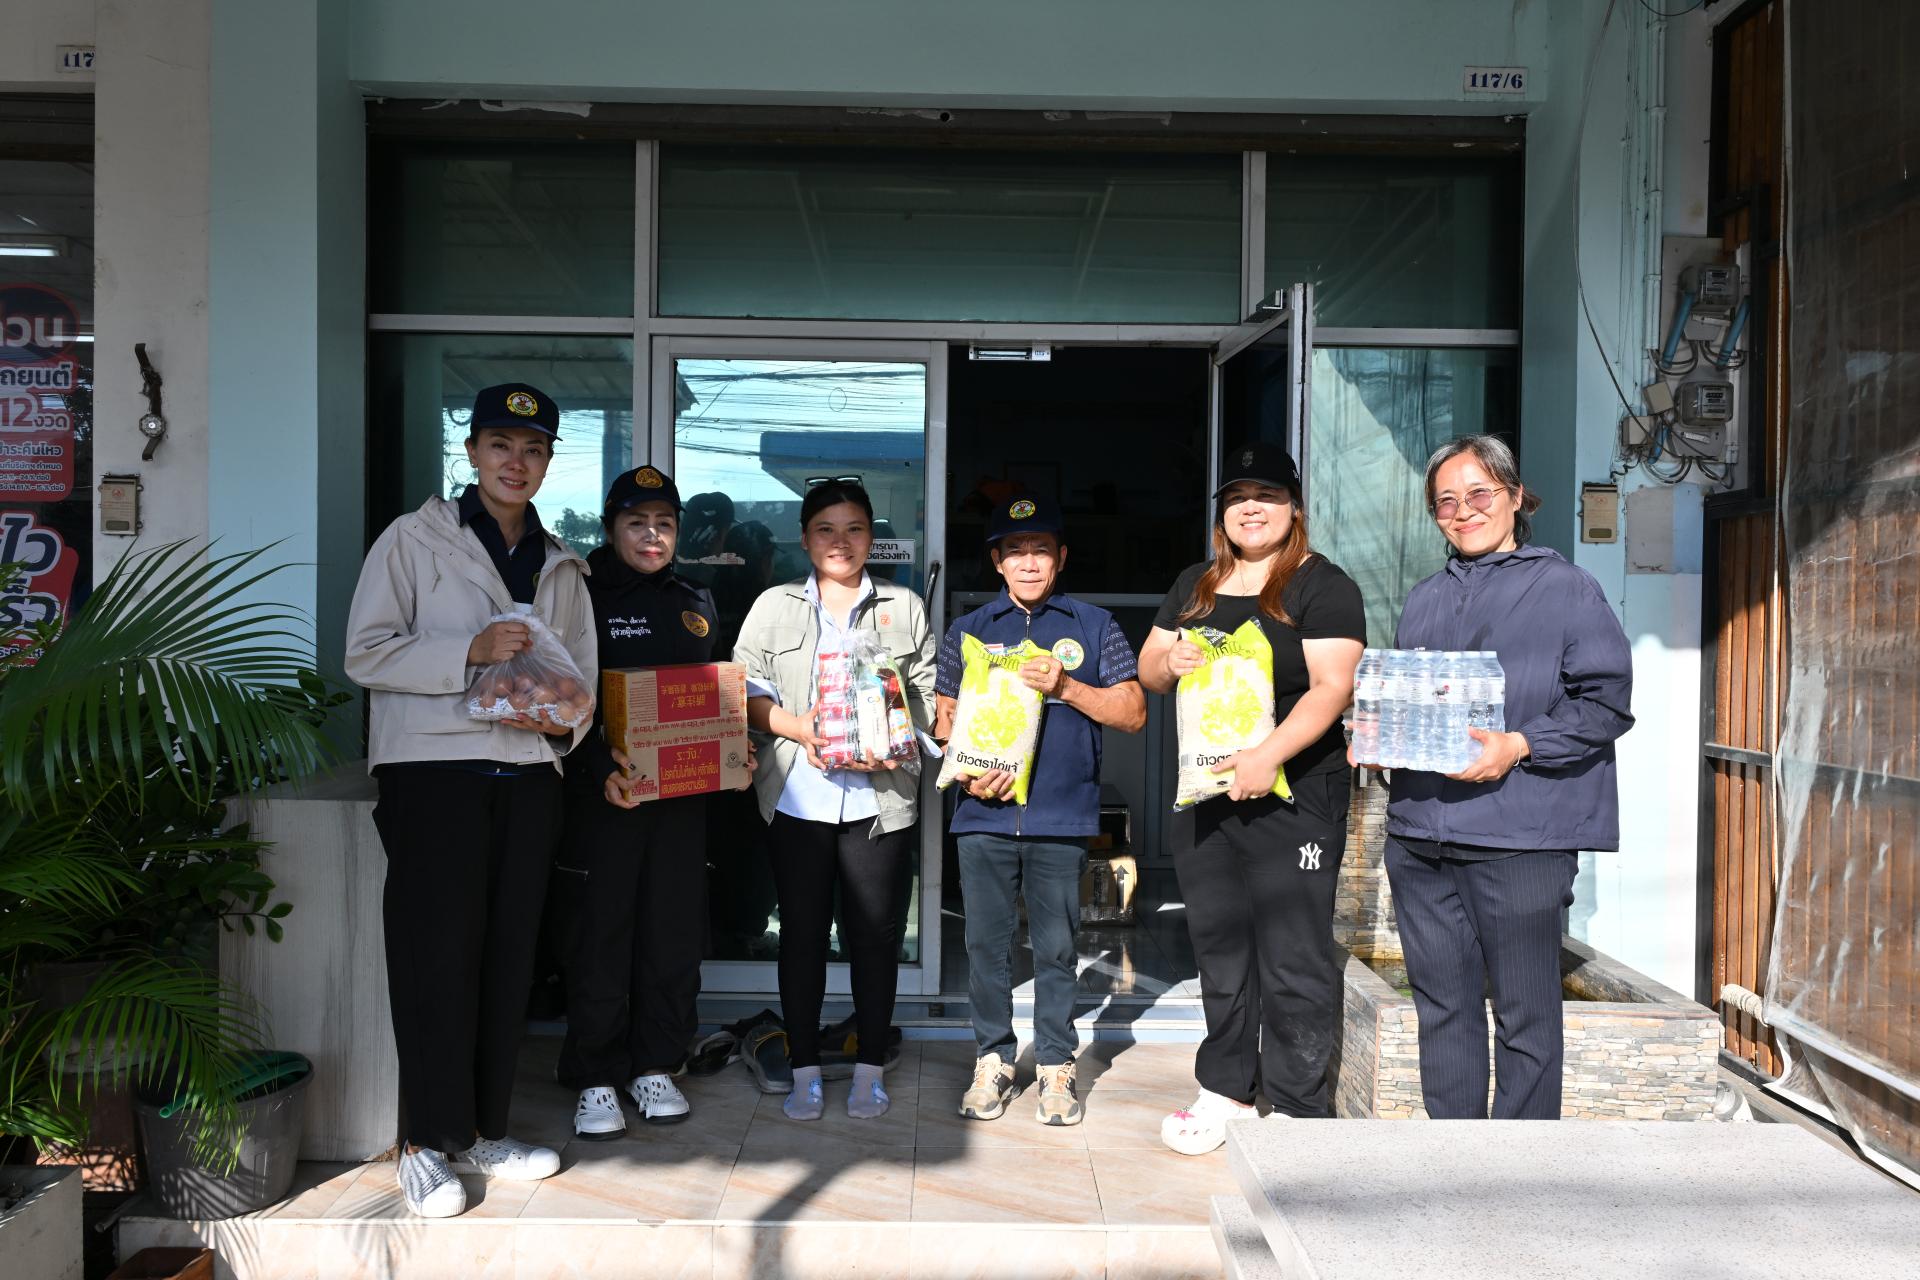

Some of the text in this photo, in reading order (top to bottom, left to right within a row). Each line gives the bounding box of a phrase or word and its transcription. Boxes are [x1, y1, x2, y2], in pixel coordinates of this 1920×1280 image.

[64, 52, 94, 67] 117
[1469, 73, 1523, 88] 117/6
[0, 317, 63, 348] วน
[956, 751, 1019, 773] ข้าวตราไก่แจ้
